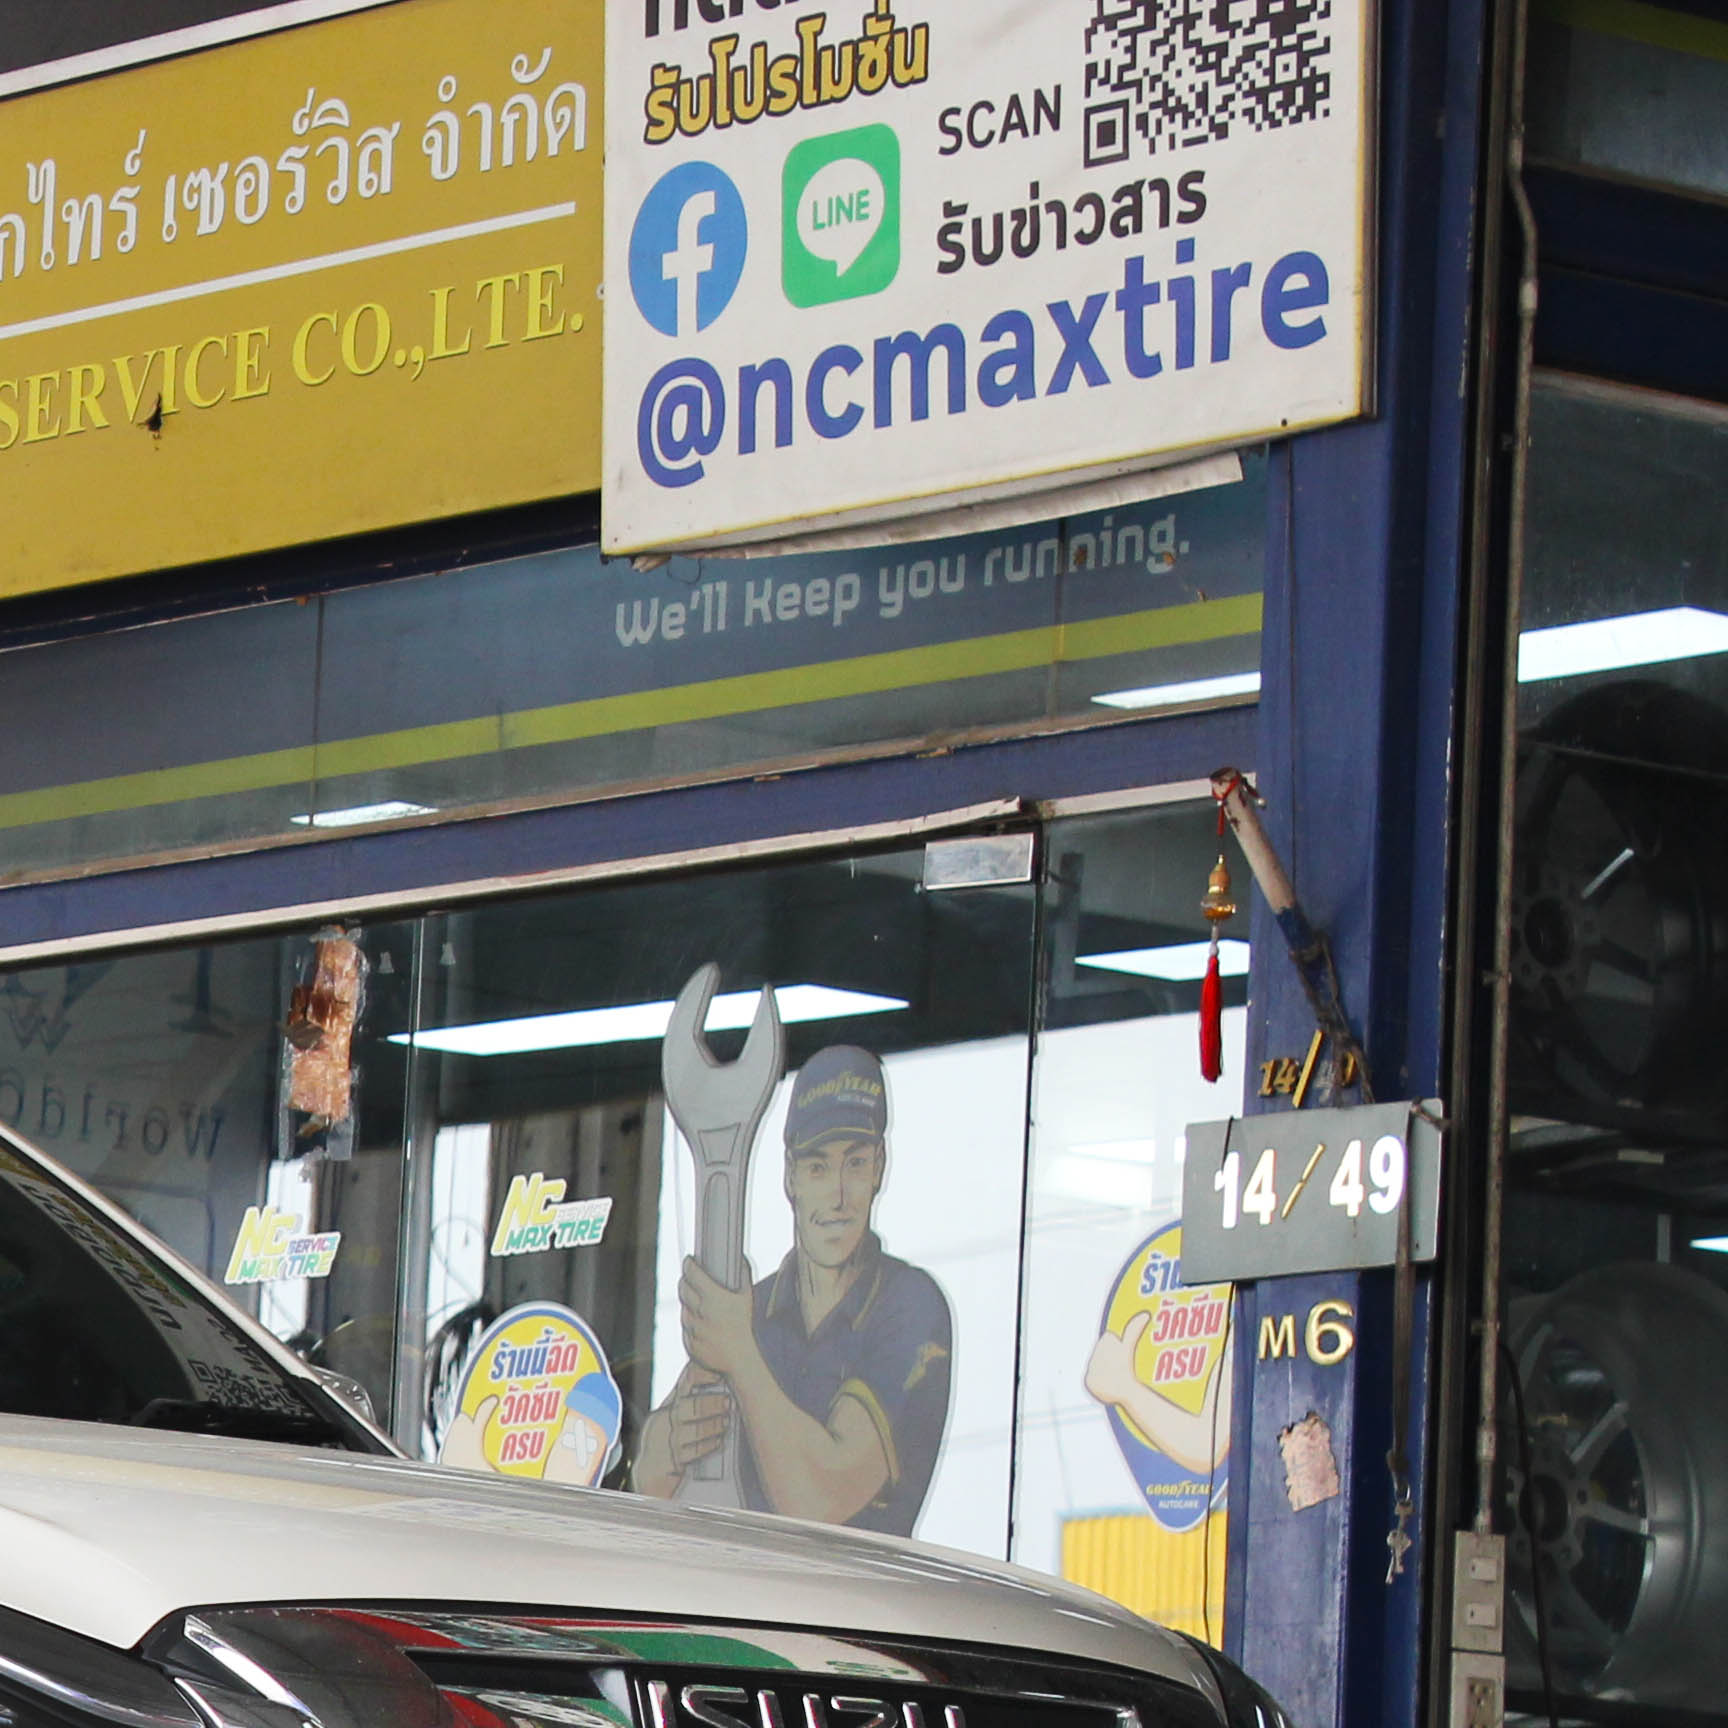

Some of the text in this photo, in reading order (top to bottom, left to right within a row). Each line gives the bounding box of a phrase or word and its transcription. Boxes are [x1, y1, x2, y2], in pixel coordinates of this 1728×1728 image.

[161, 87, 401, 243] เซอร์วิส
[421, 46, 587, 181] จำกัด
[938, 84, 1063, 156] SCAN
[812, 189, 870, 231] LINE
[936, 168, 1209, 276] รับข่าวสาร
[636, 238, 1330, 489] @ncmaxtire
[615, 580, 727, 648] We'll
[878, 553, 965, 618] you
[1215, 1135, 1407, 1229] 14/49
[229, 1208, 338, 1280] NC SERVICE
[495, 1175, 565, 1252] NC
[506, 1217, 605, 1250] MAX TIRE
[288, 1252, 333, 1275] TIRE
[1153, 1294, 1224, 1343] วัคซีน
[491, 1328, 578, 1381] ร้านนี้ฉีด
[1155, 1346, 1206, 1382] ครบ
[500, 1384, 561, 1425] วัคซีน
[500, 1430, 545, 1465] ครบ
